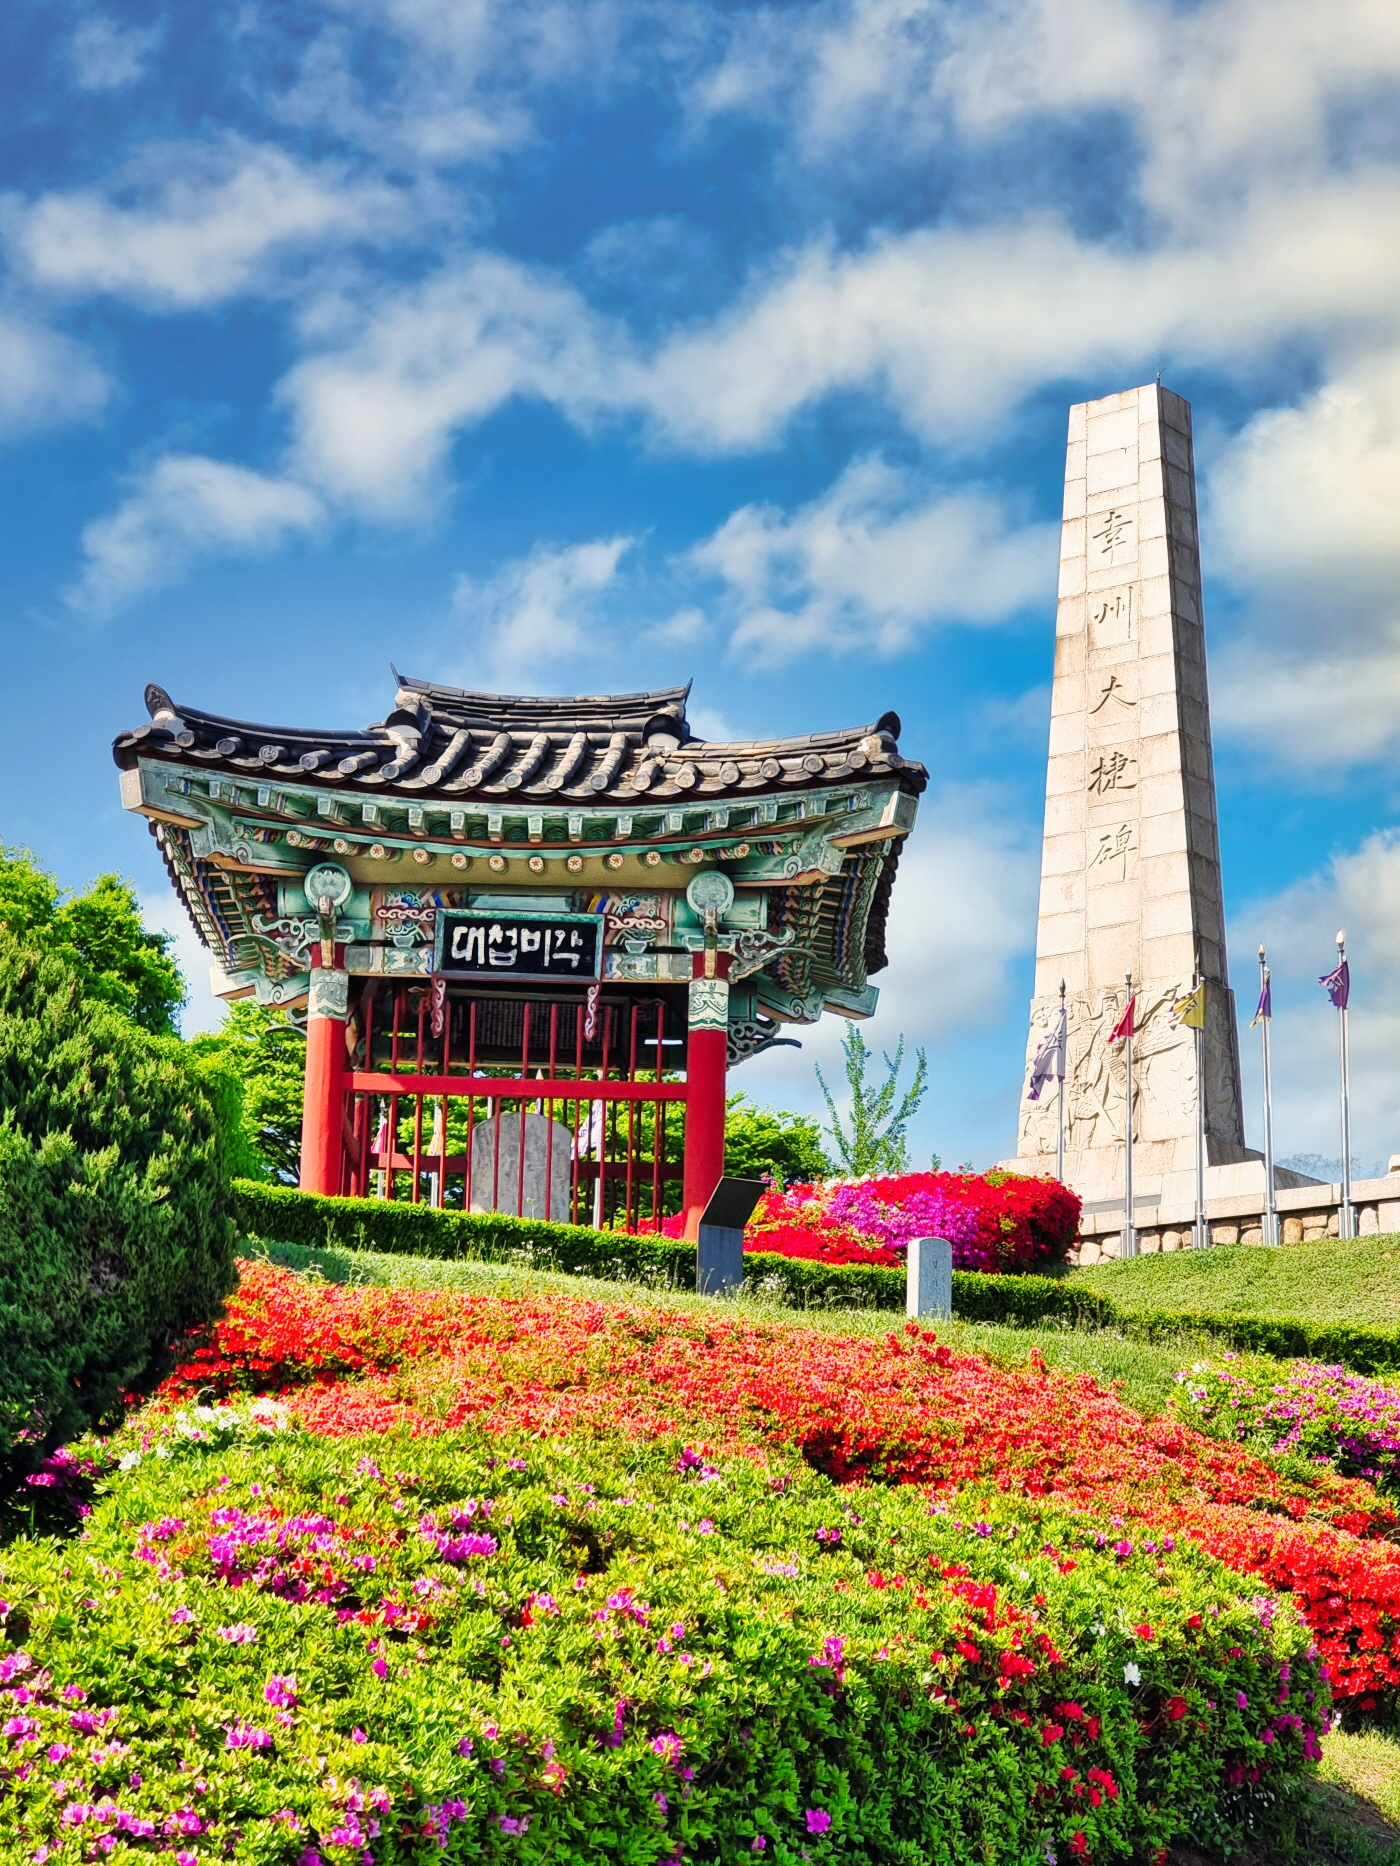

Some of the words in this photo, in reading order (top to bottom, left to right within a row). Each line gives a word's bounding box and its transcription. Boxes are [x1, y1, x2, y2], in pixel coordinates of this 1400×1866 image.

[1088, 511, 1138, 881] 幸州大捷碑
[451, 924, 583, 968] 대첩비각
